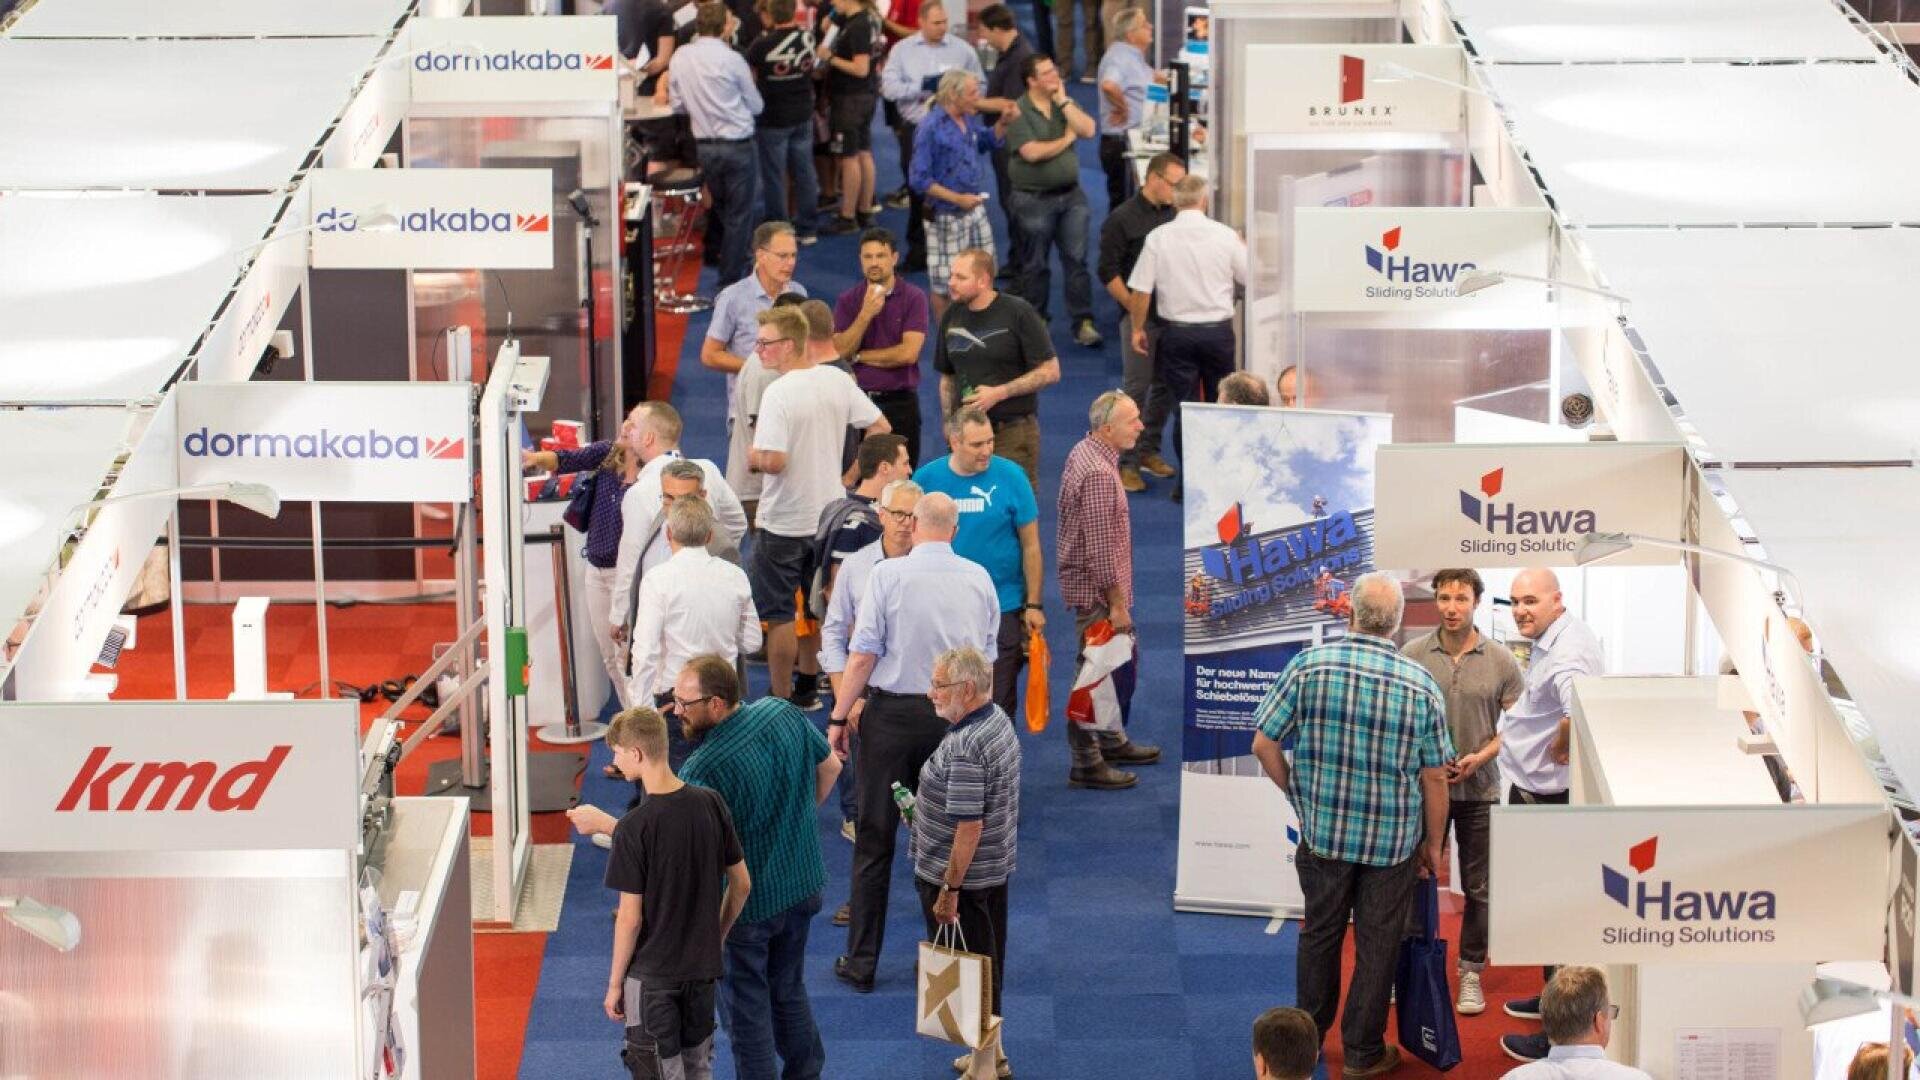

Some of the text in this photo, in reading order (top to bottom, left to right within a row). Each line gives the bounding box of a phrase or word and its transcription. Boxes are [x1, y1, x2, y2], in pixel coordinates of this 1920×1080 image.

[414, 48, 581, 71] dormakaba
[1309, 106, 1392, 116] BRUNEX
[316, 207, 511, 231] doakaba
[1365, 286, 1413, 300] Sliding
[184, 427, 419, 459] dormakaba
[1487, 503, 1597, 535] Hawa
[1229, 510, 1358, 585] Hawa
[1460, 539, 1517, 556] Sliding
[1196, 665, 1216, 677] Der
[1218, 668, 1246, 679] neue
[1196, 677, 1211, 688] für
[55, 745, 293, 811] kmd
[1636, 881, 1777, 921] Hawa
[1602, 926, 1776, 946] Sliding Solutions
